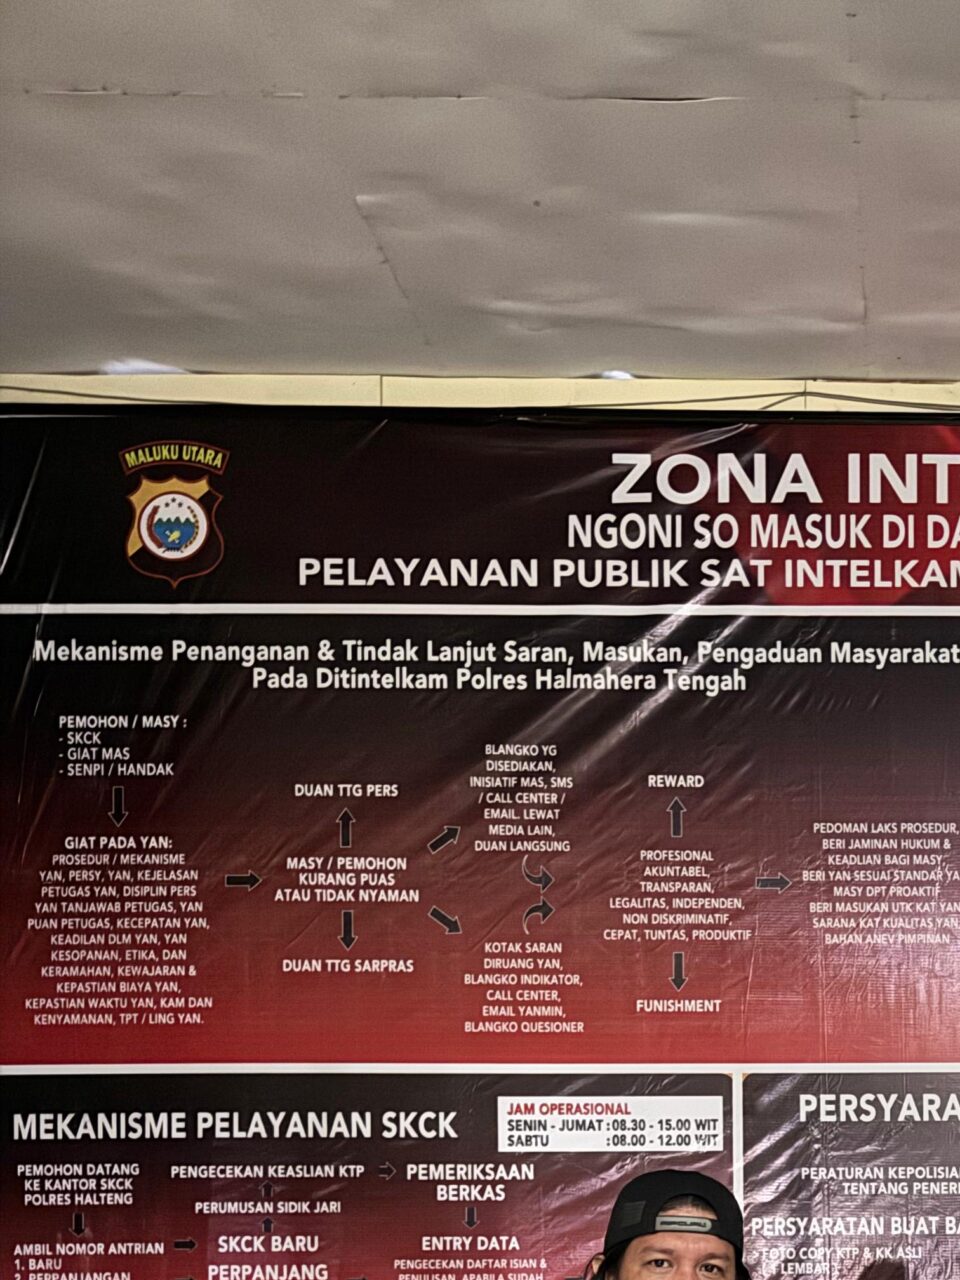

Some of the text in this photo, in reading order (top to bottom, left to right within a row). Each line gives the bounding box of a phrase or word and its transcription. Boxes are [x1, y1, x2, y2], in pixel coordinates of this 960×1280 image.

[125, 444, 223, 468] MALUKU UTARA
[611, 453, 823, 505] ZONA
[569, 513, 681, 549] NGONI
[694, 514, 738, 549] SO
[751, 514, 872, 548] MASUK
[883, 515, 914, 548] DI
[300, 558, 537, 586] PELAYANAN
[554, 559, 688, 587] PUBLIK
[698, 559, 772, 588] SAT
[34, 639, 960, 669] Mekanisme Penanganan & Tindak Lanjut Saran, Masukan, Pengaduan Masyarakat
[252, 667, 747, 696] Pada Ditintelkam Polres Halmahera Tengah
[648, 775, 704, 787] REWARD
[295, 784, 398, 796] DUAN TTG PERS
[287, 857, 323, 869] MASY
[337, 857, 406, 870] PEMOHON
[299, 873, 395, 886] KURANG PUAS
[275, 889, 419, 902] ATAU TIDAK NYAMAN
[283, 960, 413, 972] DUAN TTG SARPRAS
[637, 1000, 721, 1012] FUNISHMENT
[507, 1103, 631, 1115] JAM OPERASIONAL
[14, 1112, 458, 1139] MEKANISME PELAYANAN SKCK
[508, 1119, 547, 1131] SENIN
[559, 1119, 603, 1131] JUMAT
[607, 1119, 645, 1131] :08.30
[658, 1119, 690, 1131] 15.00
[695, 1119, 718, 1131] WIT
[508, 1135, 549, 1146] SABTU
[607, 1135, 646, 1146] :08.00
[658, 1135, 691, 1146] 12.00
[407, 1164, 534, 1180] PEMERIKSAAN
[437, 1184, 505, 1201] BERKAS
[751, 1217, 885, 1237] PERSYARATAN
[891, 1217, 939, 1236] BUAT
[219, 1236, 318, 1252] SKCK BARU
[423, 1236, 520, 1250] ENTRY DATA
[209, 1264, 328, 1280] PERPANJANG
